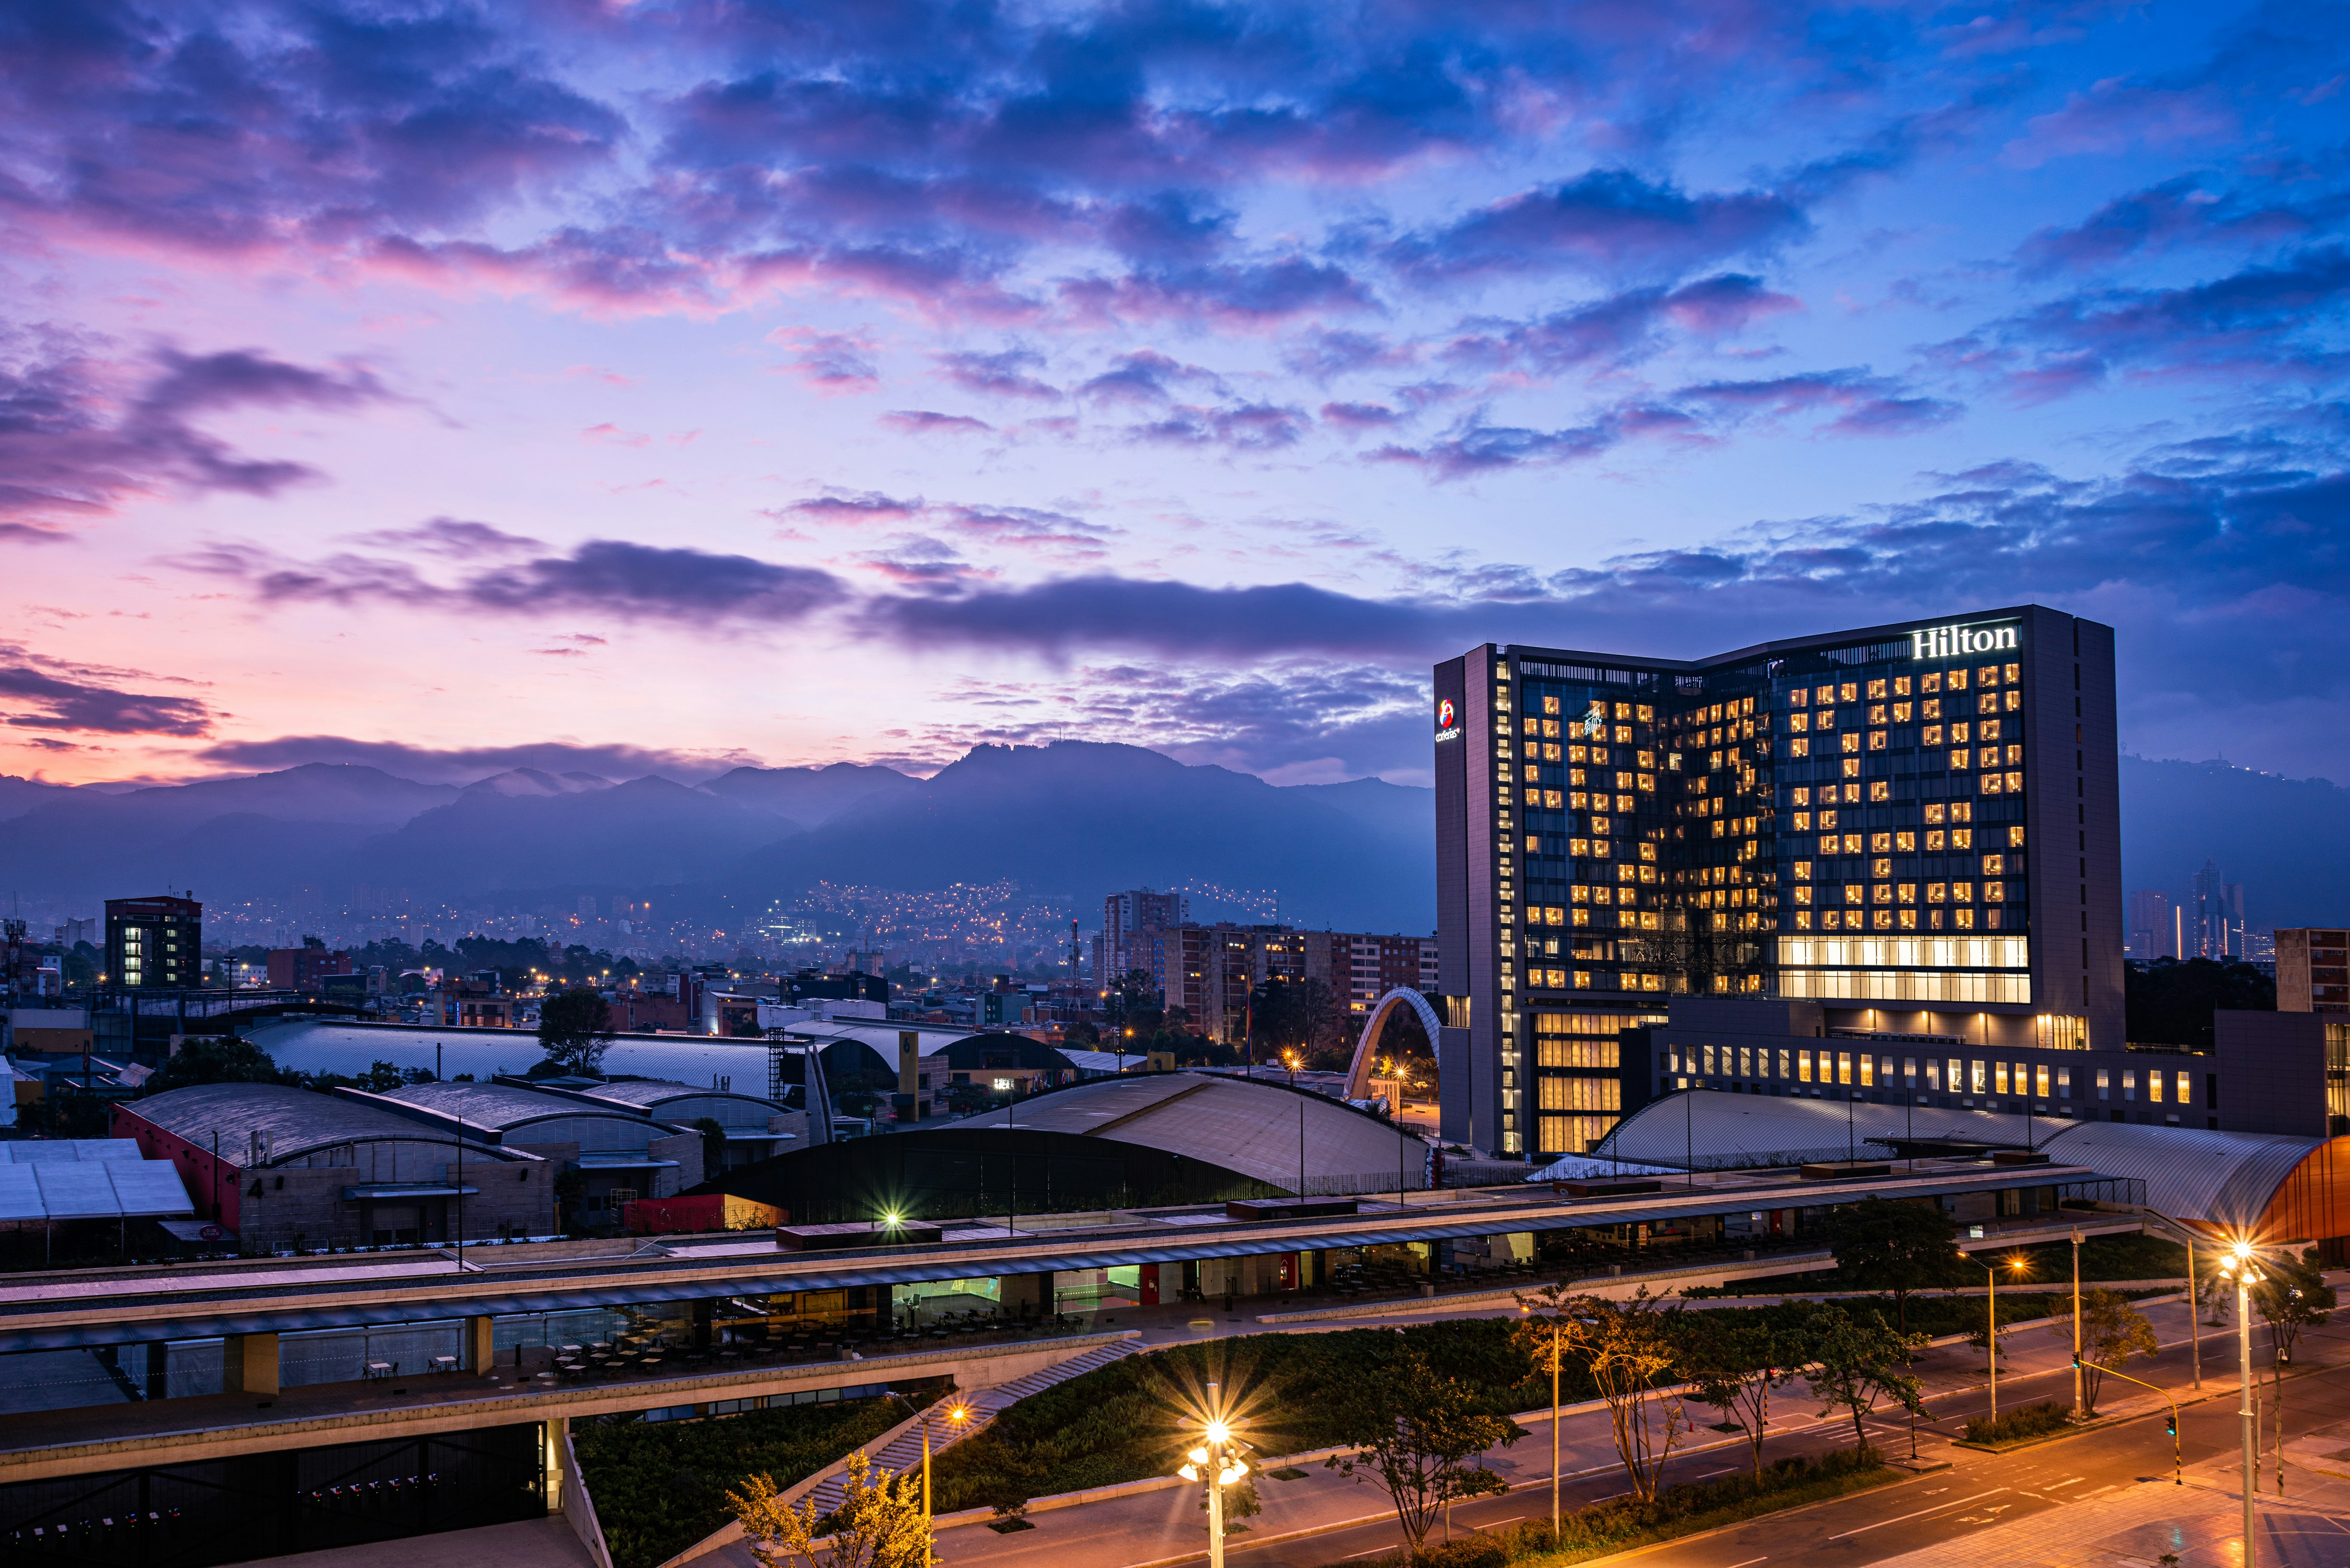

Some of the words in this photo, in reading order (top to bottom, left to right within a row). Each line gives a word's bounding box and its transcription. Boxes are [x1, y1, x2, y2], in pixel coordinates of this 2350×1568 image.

[1913, 627, 2017, 659] Hilton
[903, 1037, 910, 1053] 6
[248, 1179, 263, 1198] 4
